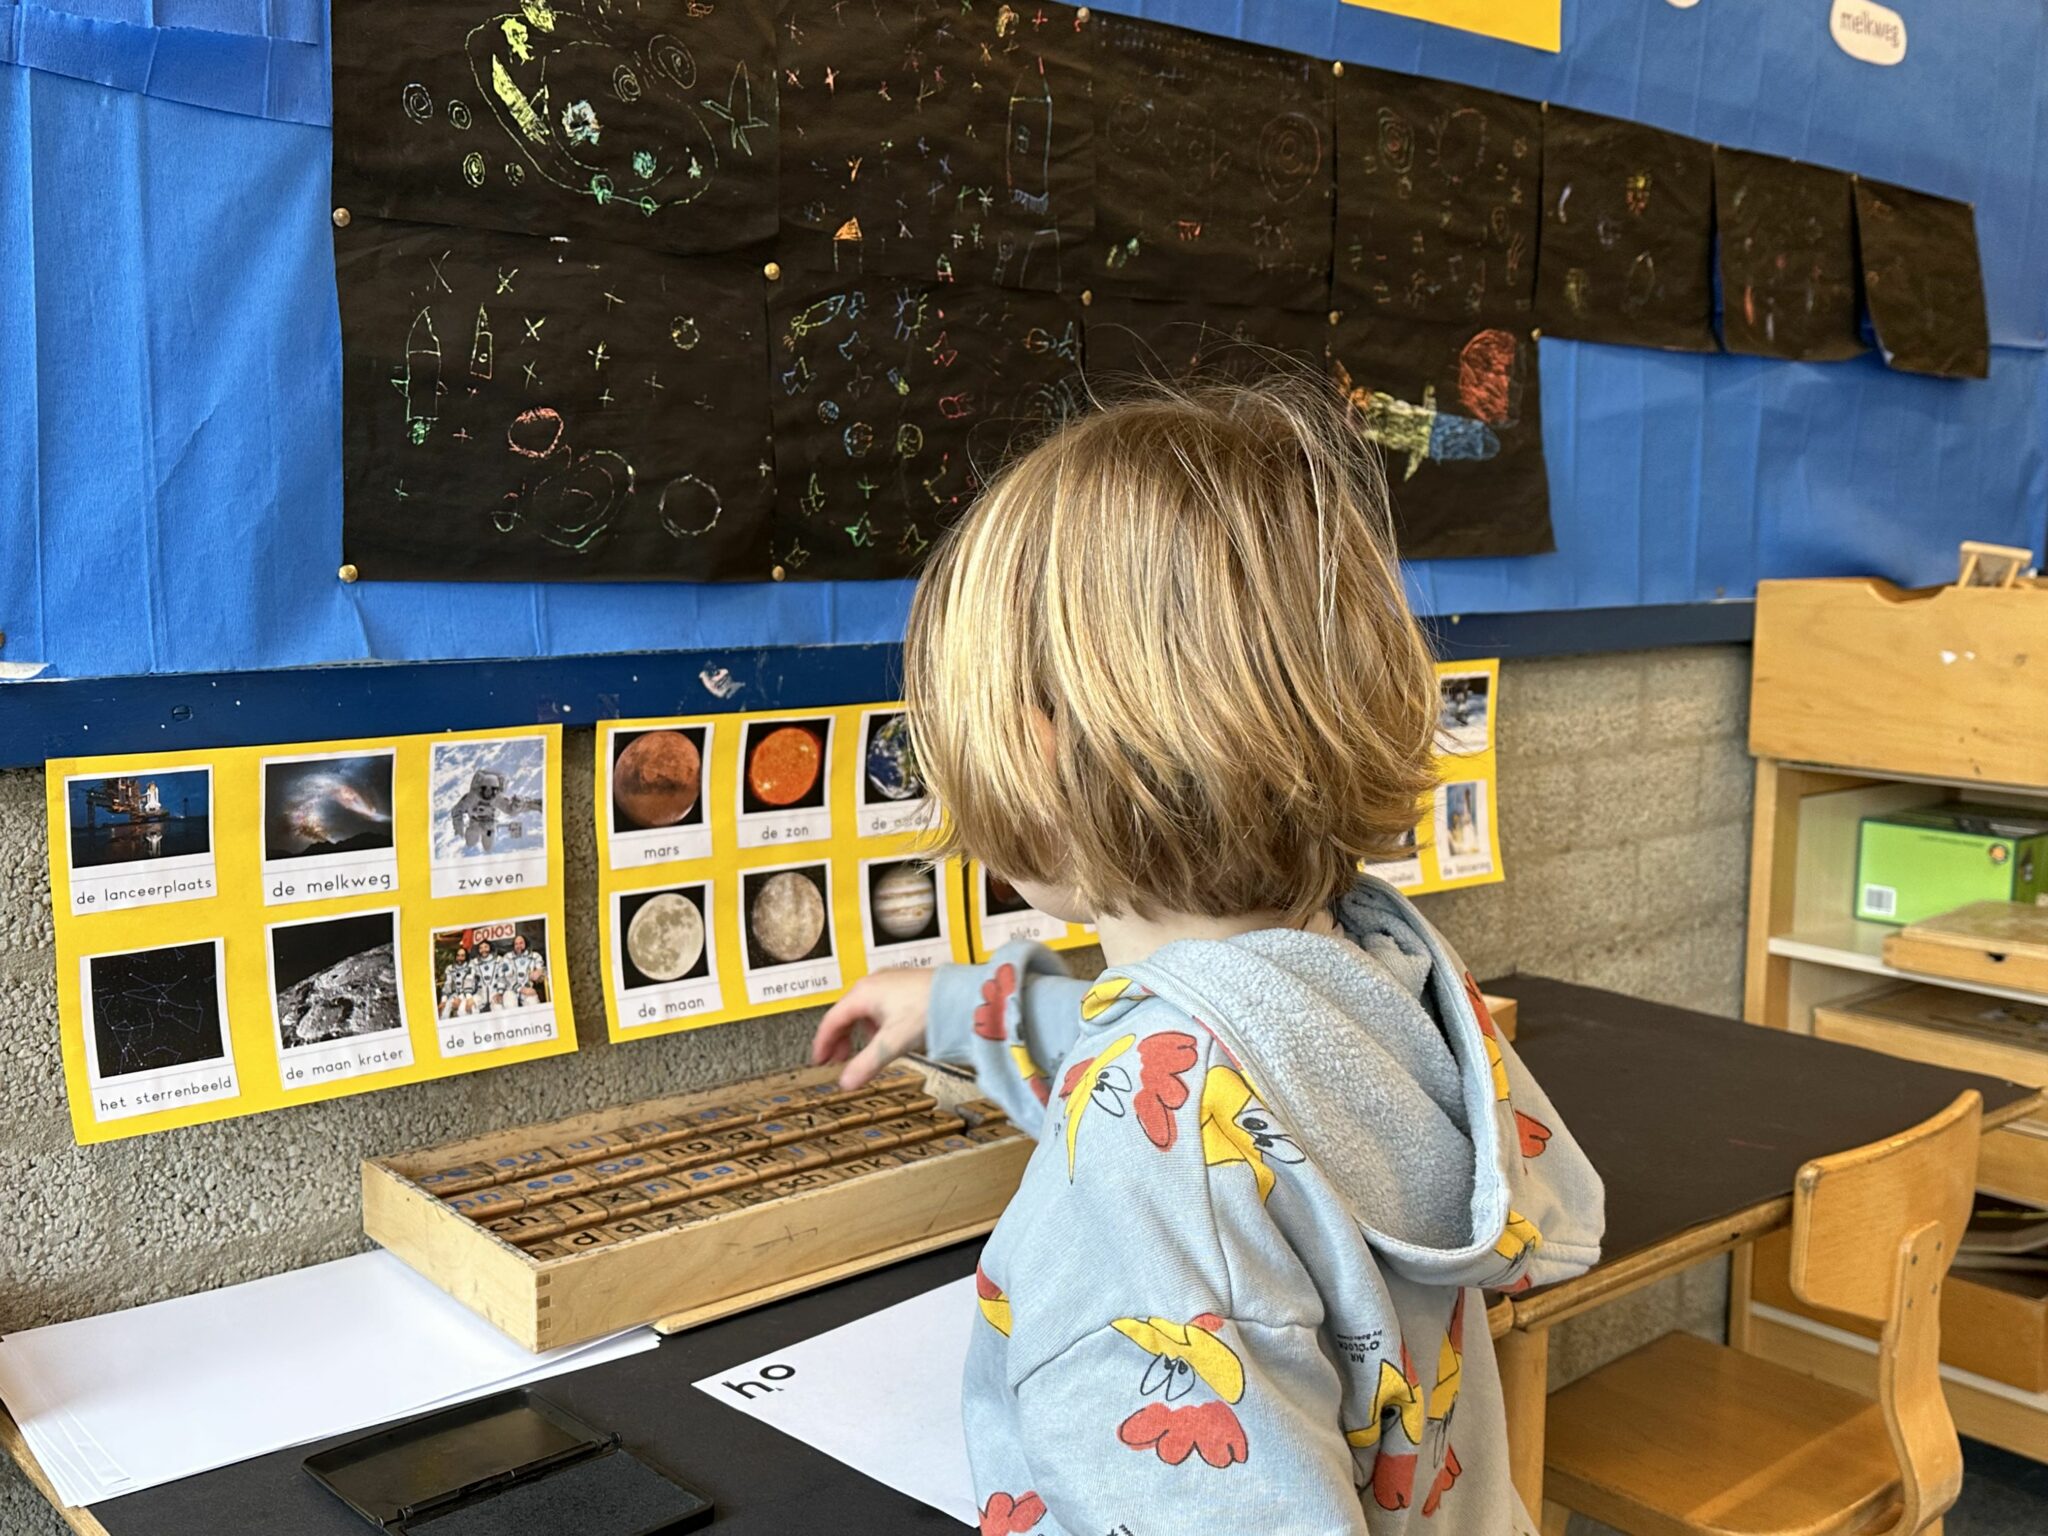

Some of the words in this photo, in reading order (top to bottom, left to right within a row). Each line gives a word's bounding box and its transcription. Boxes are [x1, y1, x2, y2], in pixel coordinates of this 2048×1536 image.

[761, 825, 778, 842] de
[785, 826, 809, 839] zon
[872, 816, 887, 830] de
[644, 845, 680, 860] mars
[76, 890, 97, 905] de
[104, 877, 213, 905] lanceerplaats
[272, 880, 296, 899] de
[307, 872, 392, 896] melkweg
[458, 873, 524, 893] zweven
[762, 976, 832, 999] mercurius
[638, 1003, 657, 1020] de
[664, 998, 706, 1015] maan
[446, 1035, 465, 1051] de
[472, 1022, 554, 1047] bemanning
[285, 1066, 305, 1081] de
[312, 1060, 352, 1076] maan
[358, 1049, 404, 1067] krater
[100, 1096, 127, 1112] het
[135, 1077, 232, 1105] sterrenbeeld
[663, 1141, 712, 1157] ng
[572, 1231, 603, 1247] d
[845, 1157, 892, 1175] nk
[489, 1213, 541, 1233] ch
